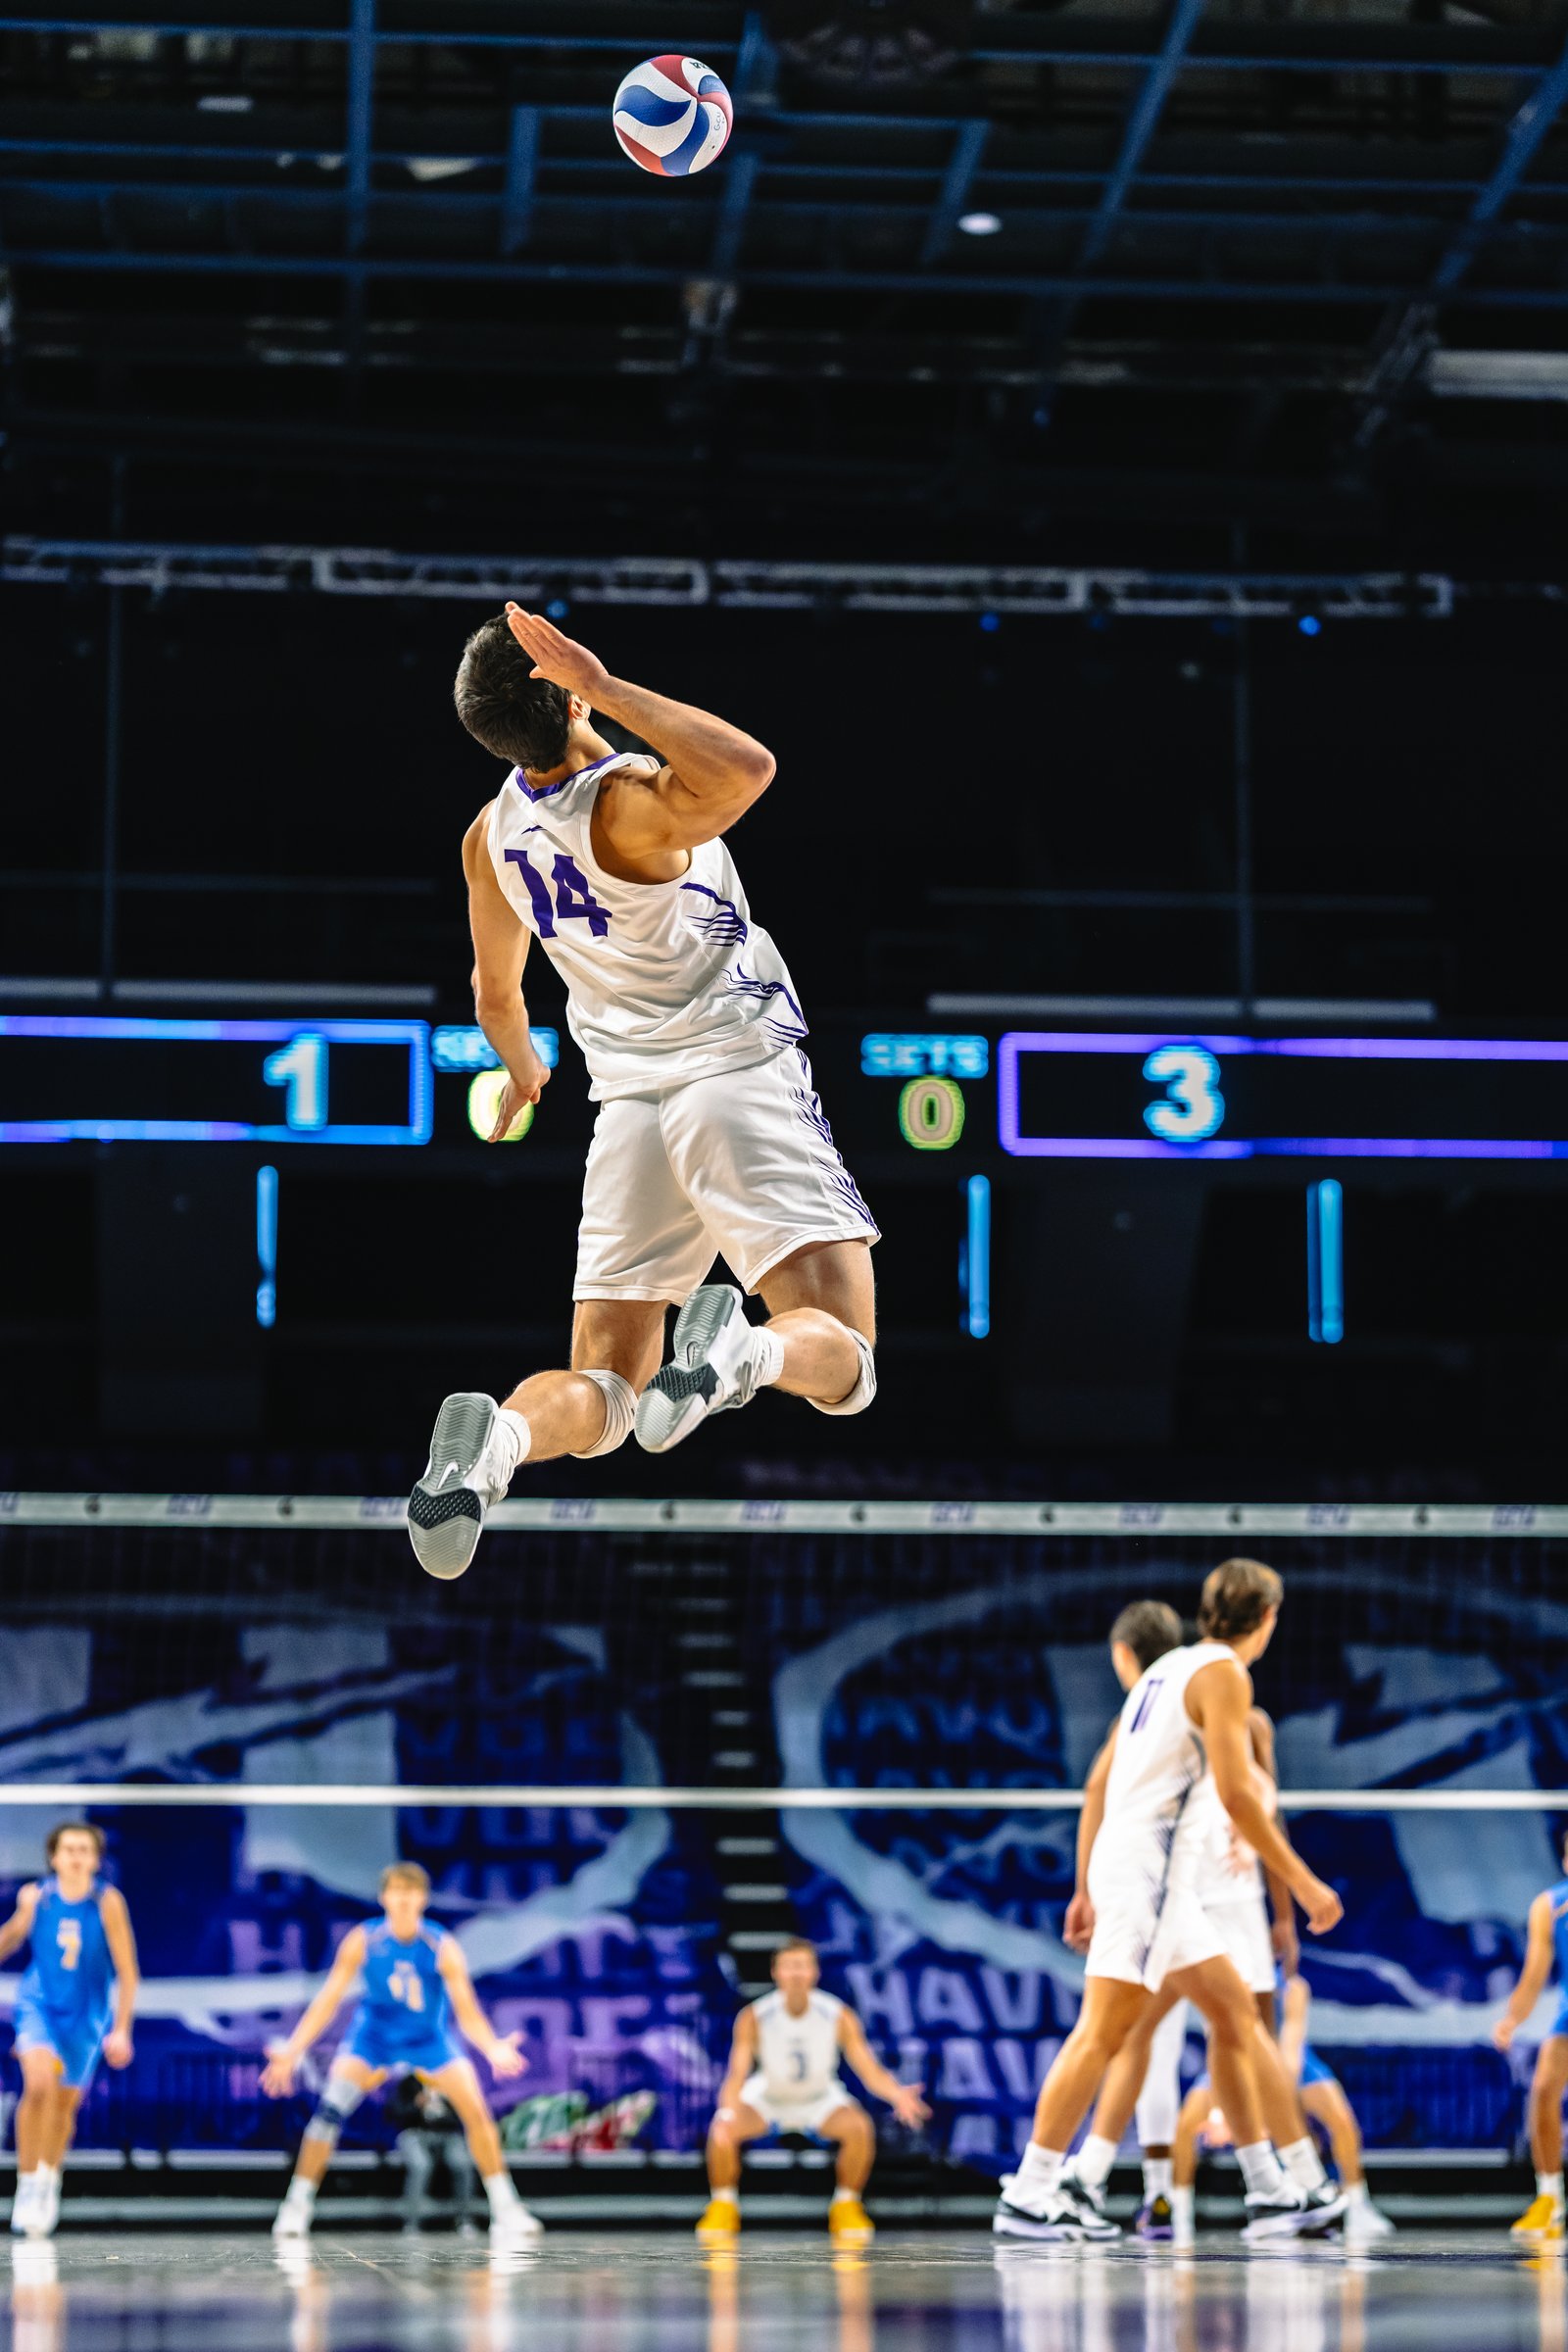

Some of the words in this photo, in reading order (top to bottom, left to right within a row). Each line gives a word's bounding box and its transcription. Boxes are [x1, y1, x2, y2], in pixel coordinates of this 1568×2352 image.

[504, 849, 612, 938] 14
[264, 1032, 329, 1131] 1
[899, 1077, 965, 1150] 0
[1143, 1045, 1225, 1143] 3
